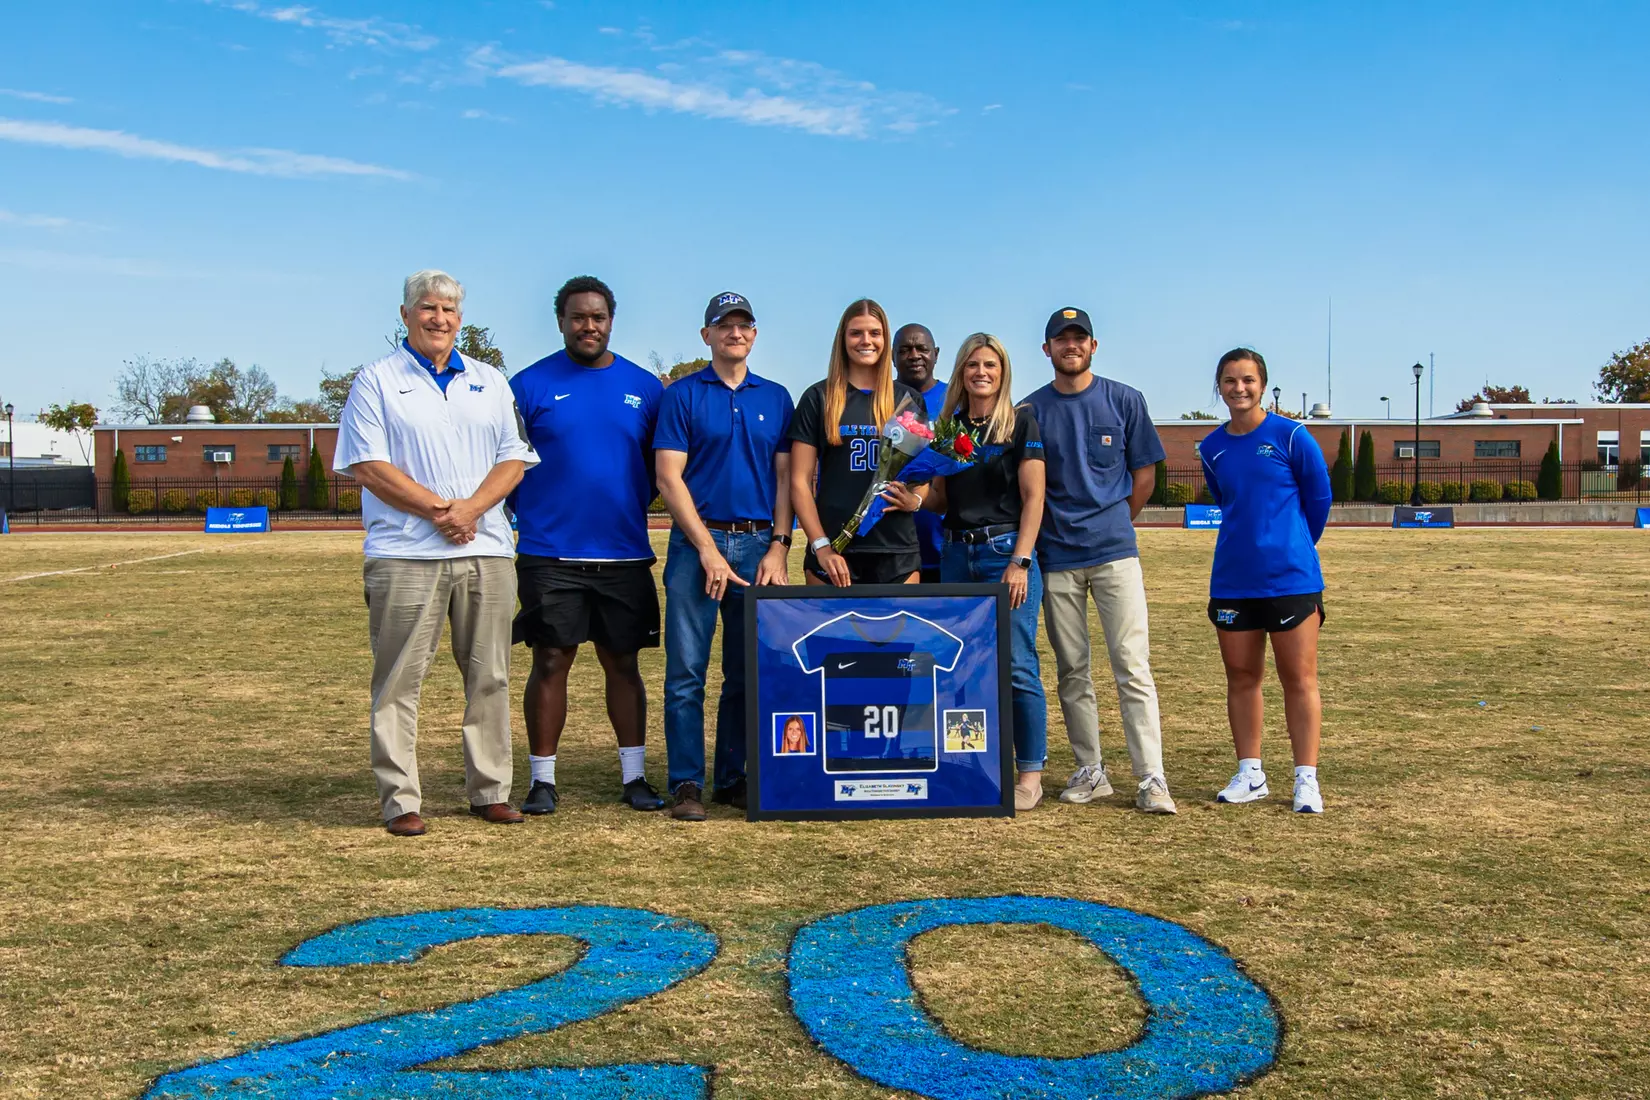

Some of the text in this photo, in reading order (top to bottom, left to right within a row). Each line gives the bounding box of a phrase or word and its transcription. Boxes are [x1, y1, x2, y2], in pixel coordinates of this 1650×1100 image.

[718, 294, 740, 305] MT
[469, 384, 484, 393] MT
[624, 393, 642, 408] MT
[850, 438, 880, 471] 20
[1257, 445, 1273, 456] MT
[1217, 609, 1237, 624] MT
[898, 658, 916, 671] MT
[864, 705, 899, 739] 20
[840, 784, 857, 797] MT
[906, 783, 923, 796] MT
[141, 895, 1283, 1100] 20
